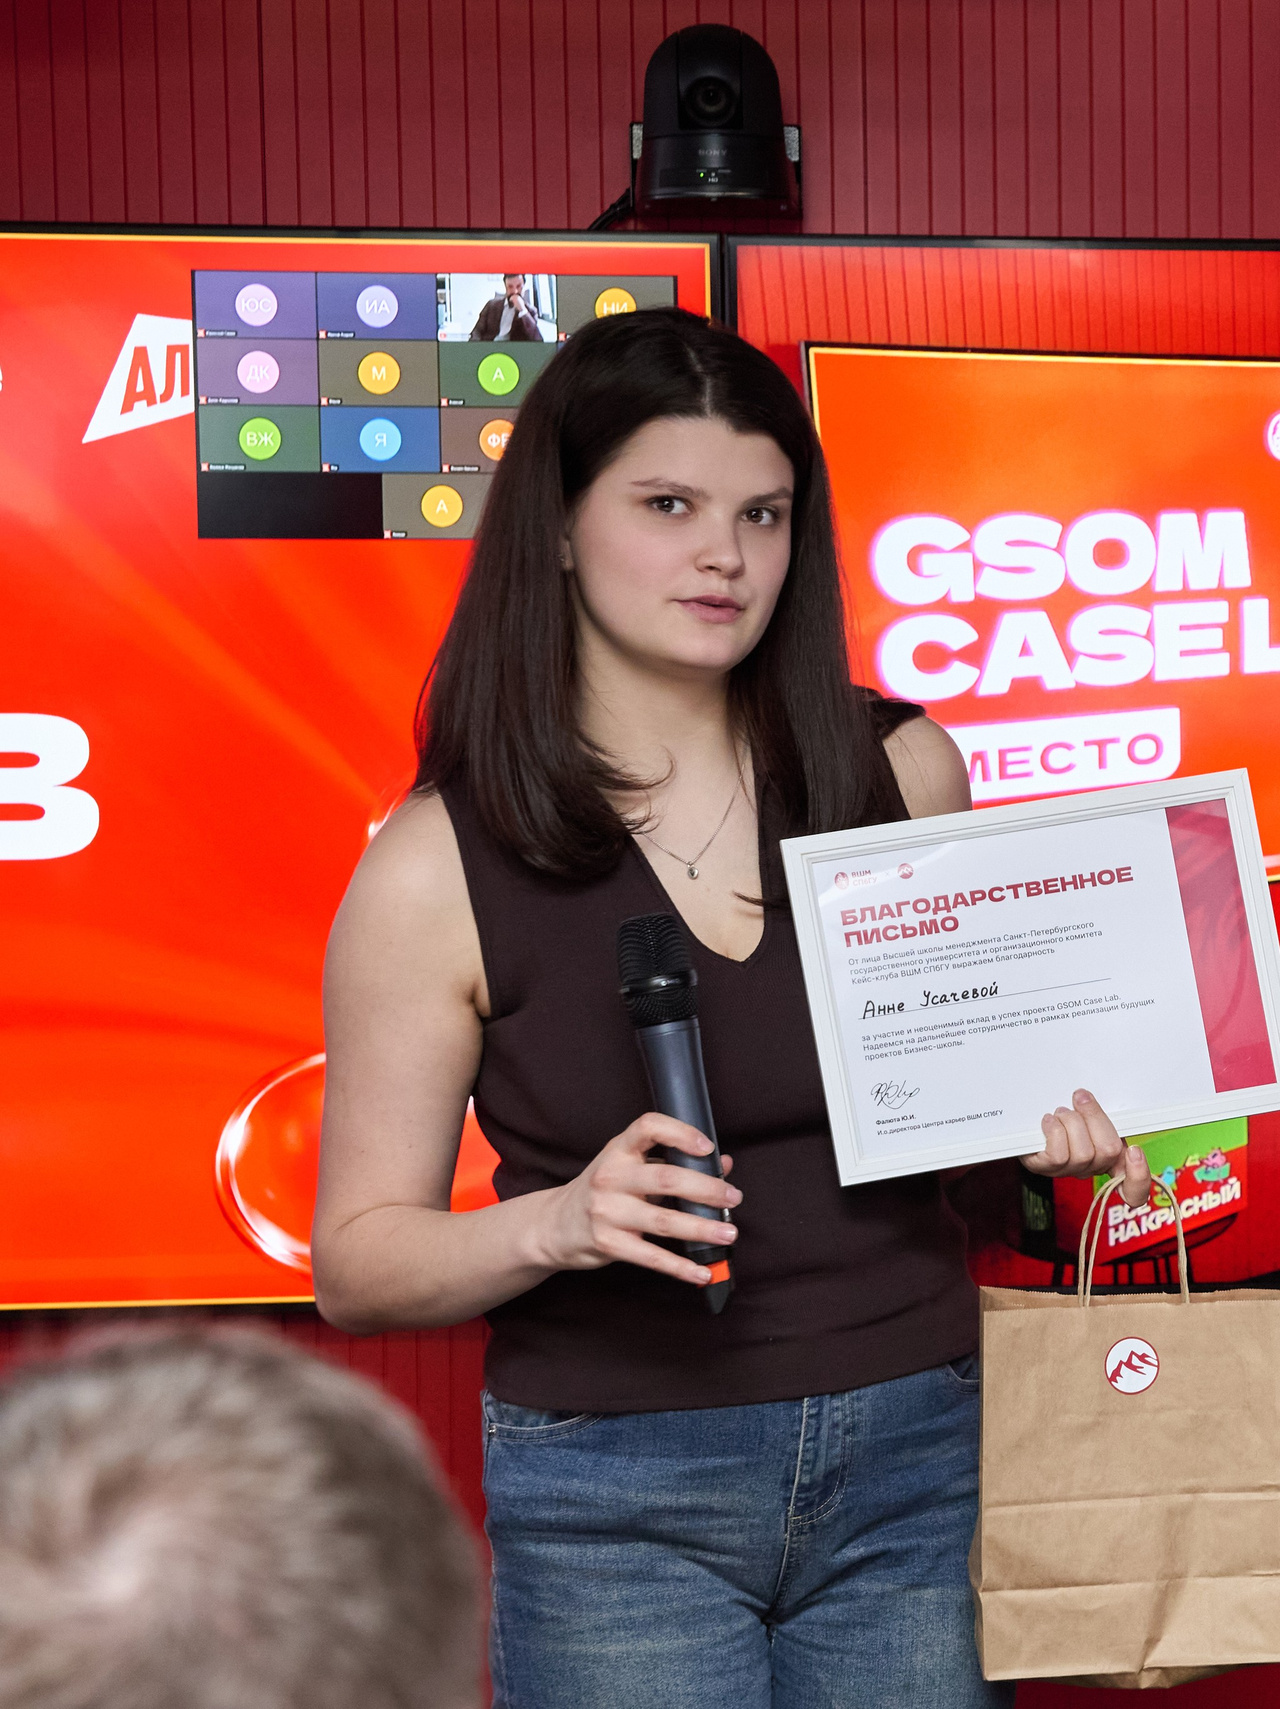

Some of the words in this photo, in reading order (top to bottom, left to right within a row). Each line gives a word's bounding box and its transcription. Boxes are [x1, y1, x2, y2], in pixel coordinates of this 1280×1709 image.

[241, 298, 272, 312] ЮС
[365, 300, 390, 314] ИА
[247, 366, 270, 383] ДК
[372, 366, 386, 380] М
[492, 367, 505, 382] А
[246, 431, 274, 447] ВЖ
[374, 433, 387, 447] Я
[435, 499, 448, 514] А
[874, 511, 1252, 605] GSOM
[880, 600, 1231, 700] CASE
[851, 869, 871, 878] ВШМ
[840, 866, 1134, 926] БЛАГОДАРСТВЕННОЕ
[844, 915, 960, 948] ПИСЬМО
[848, 957, 859, 966] От
[861, 955, 881, 965] лица
[883, 949, 916, 961] Высшей
[917, 945, 944, 956] школы
[945, 937, 1002, 951] менеджмента
[1003, 921, 1095, 942] Санкт-Петербургского
[850, 958, 924, 976] государственного
[925, 949, 981, 965] университета
[989, 936, 1064, 955] организационного
[1065, 930, 1103, 942] комитета
[851, 972, 899, 985] Кейс-клуба
[900, 967, 922, 978] ВШМ
[952, 957, 994, 970] выражаем
[995, 947, 1055, 963] благодарность
[862, 1000, 905, 1019] Анне
[920, 981, 999, 1007] Усачевой
[861, 1034, 871, 1042] за
[872, 1029, 905, 1042] участие
[913, 1019, 965, 1034] неоценимый
[966, 1015, 990, 1025] вклад
[998, 1010, 1021, 1022] успех
[1022, 1005, 1056, 1018] проекта
[1056, 999, 1082, 1010] GSOM
[1083, 996, 1103, 1006] Case
[863, 1039, 904, 1051] Надеемся
[905, 1037, 916, 1045] на
[917, 1029, 967, 1043] дальнейшее
[967, 1018, 1032, 1036] сотрудничество
[1040, 1012, 1070, 1024] рамках
[1071, 1004, 1119, 1019] реализации
[1120, 998, 1155, 1011] будущих
[864, 1049, 903, 1061] проектов
[904, 1039, 966, 1055] Бизнес-школы.
[921, 1120, 944, 1129] Центра
[967, 1112, 983, 1121] ВШМ
